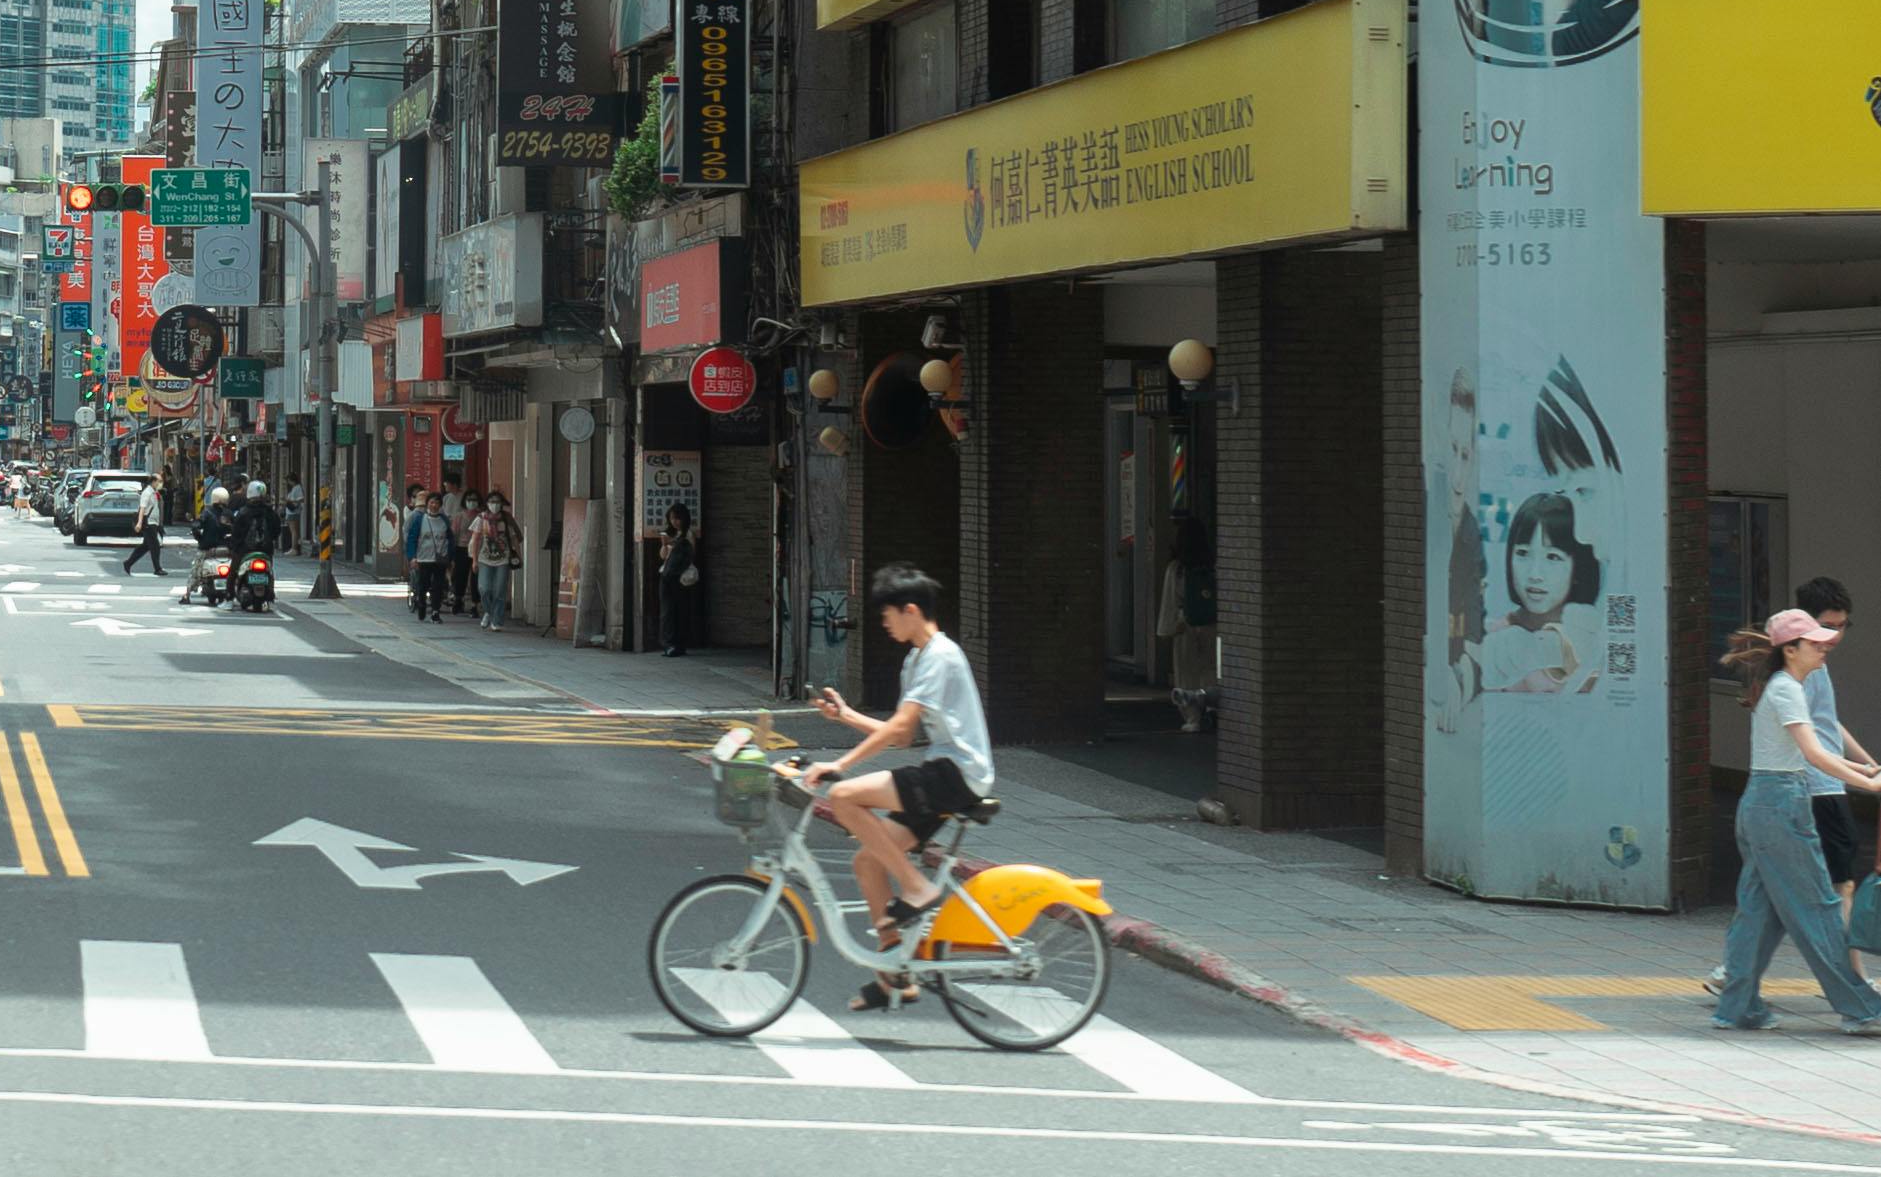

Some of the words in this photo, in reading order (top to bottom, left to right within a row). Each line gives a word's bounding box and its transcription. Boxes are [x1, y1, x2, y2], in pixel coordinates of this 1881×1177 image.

[539, 2, 551, 79] MASSAGE
[520, 94, 595, 121] 24H
[502, 131, 611, 159] 2754-9393
[1124, 121, 1150, 154] HESS
[1152, 109, 1190, 147] YOUNG
[161, 172, 239, 190] 文昌街
[166, 192, 219, 202] WenChang
[225, 191, 238, 201] St.
[990, 126, 1121, 229] 何嘉仁菁英美語
[1125, 155, 1188, 205] ENGLISH
[1192, 143, 1254, 190] SCHOOL
[136, 225, 155, 318] 台灣大哥大
